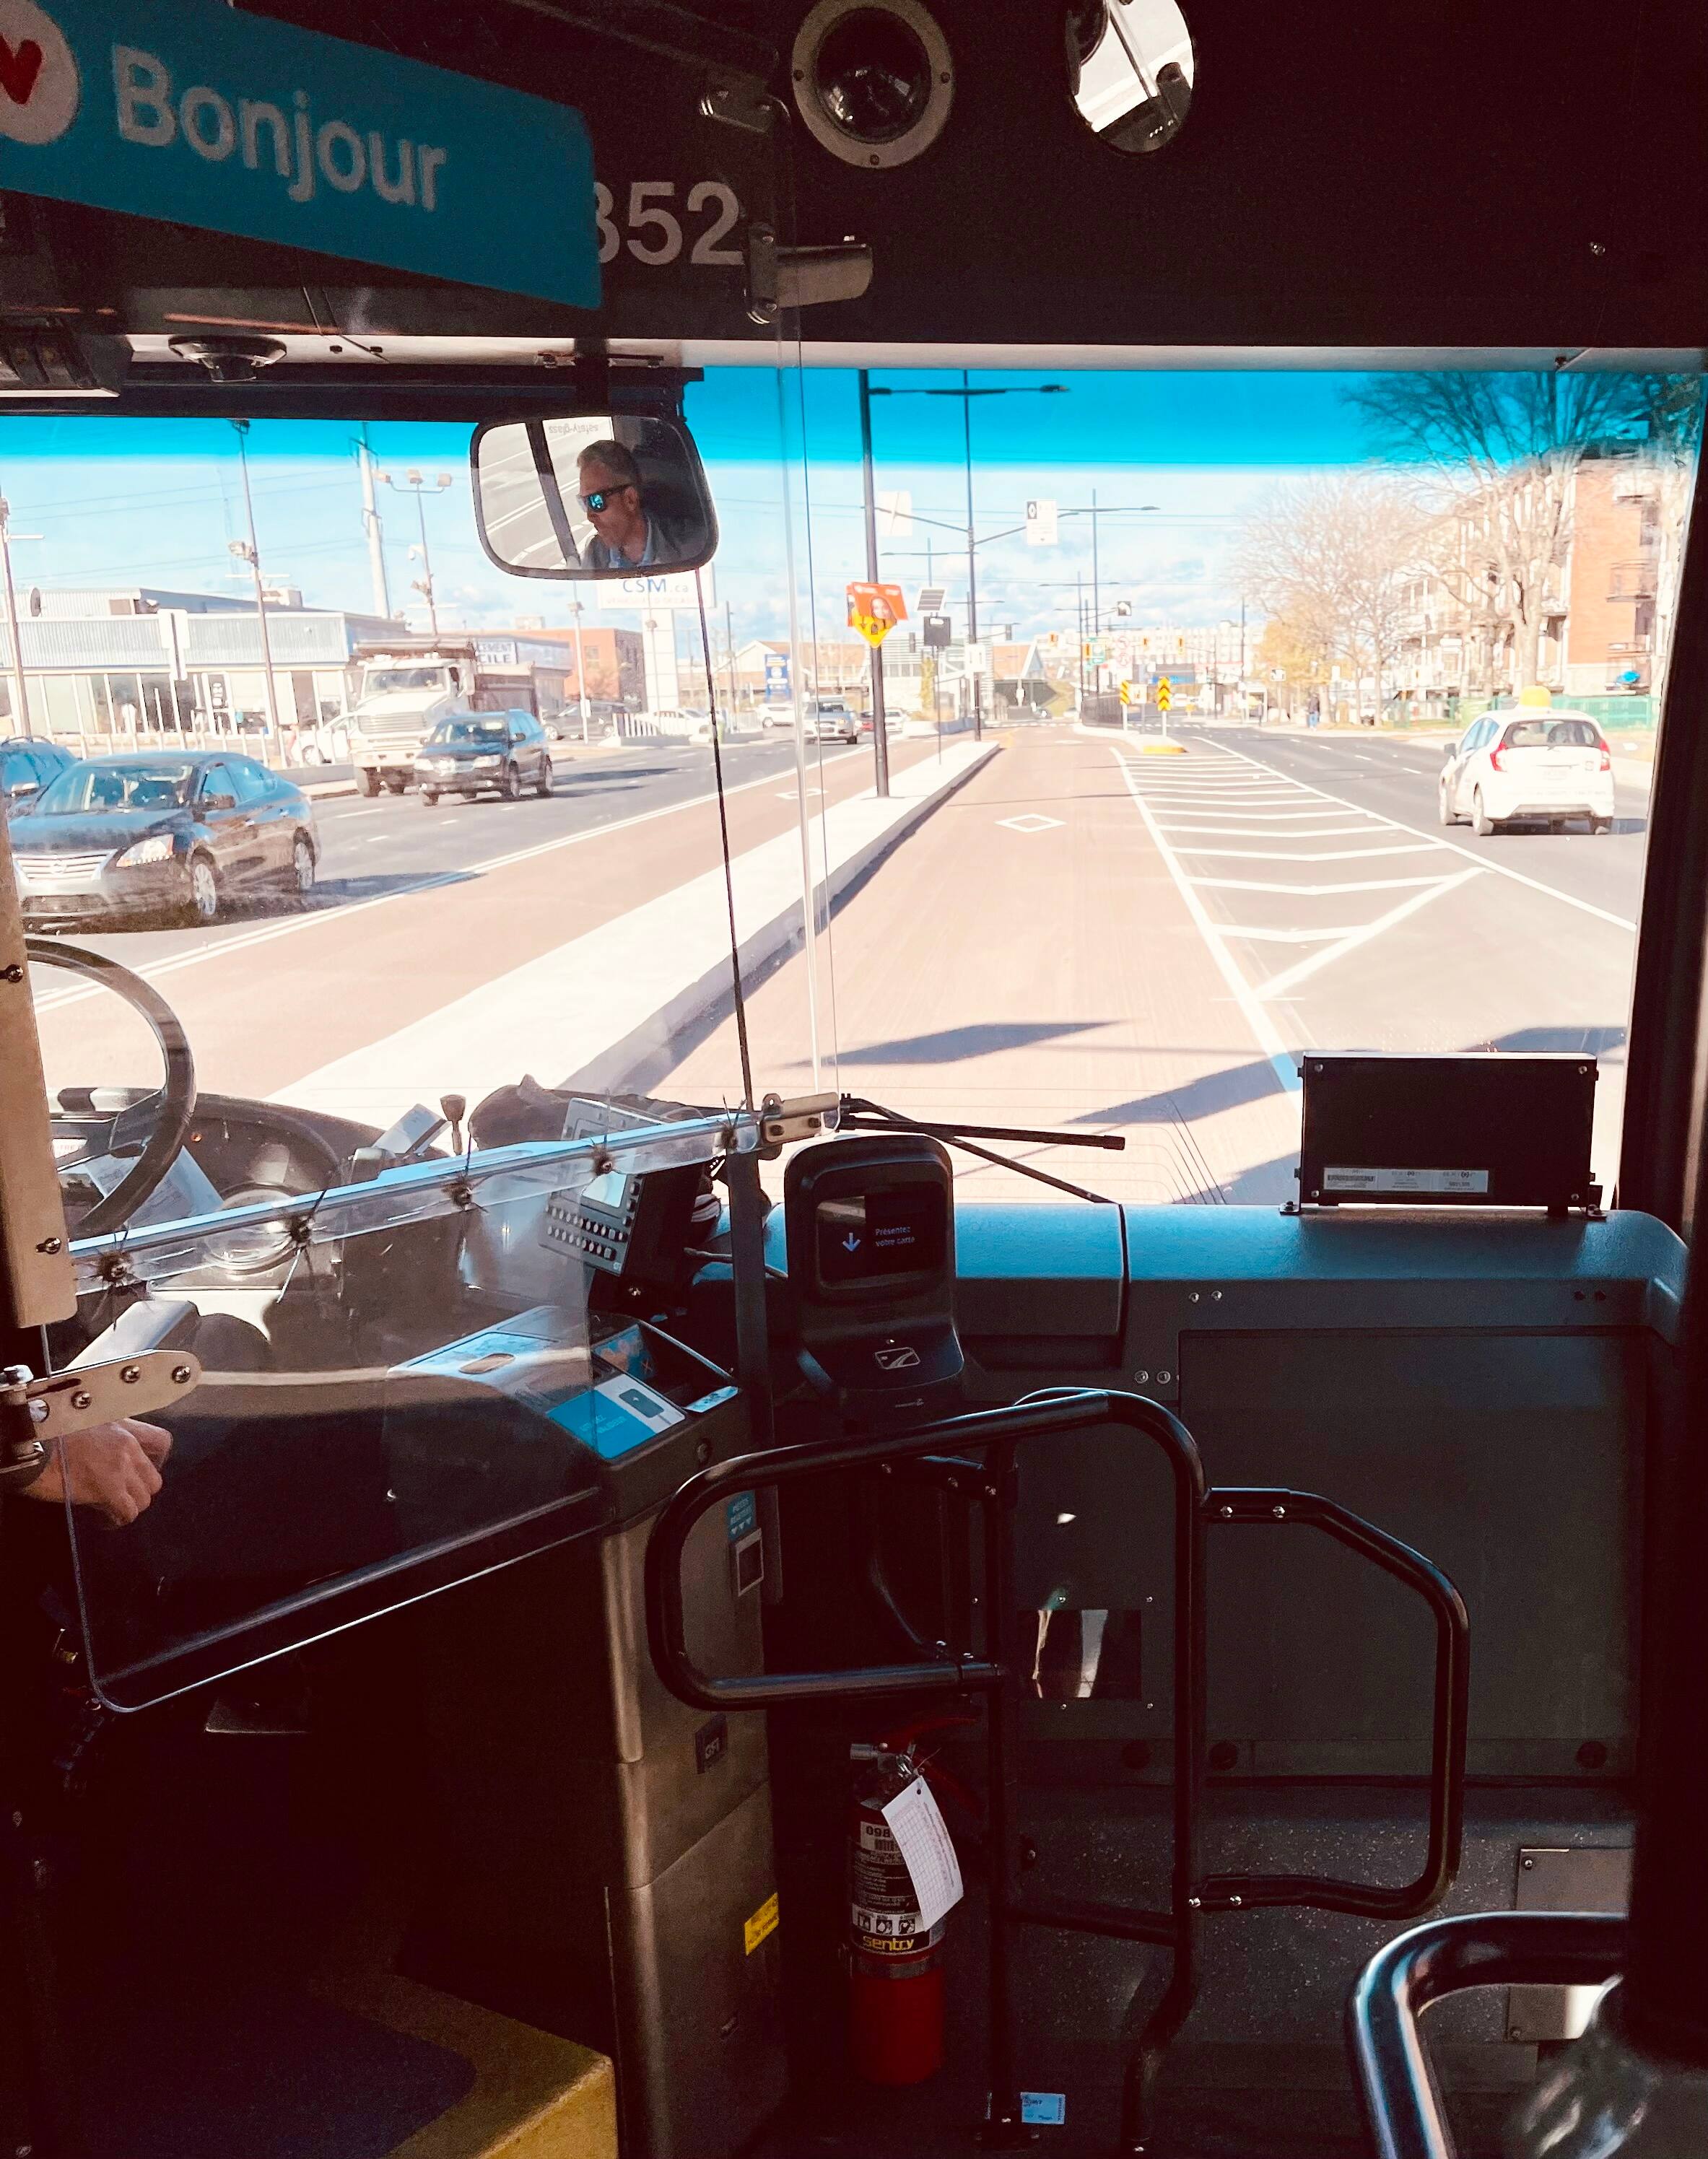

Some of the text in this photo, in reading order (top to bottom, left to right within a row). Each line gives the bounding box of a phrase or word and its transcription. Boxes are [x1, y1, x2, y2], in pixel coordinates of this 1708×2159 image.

[112, 44, 446, 211] Bonjour
[875, 1239, 895, 1247] votre
[863, 1935, 915, 1951] sentry
